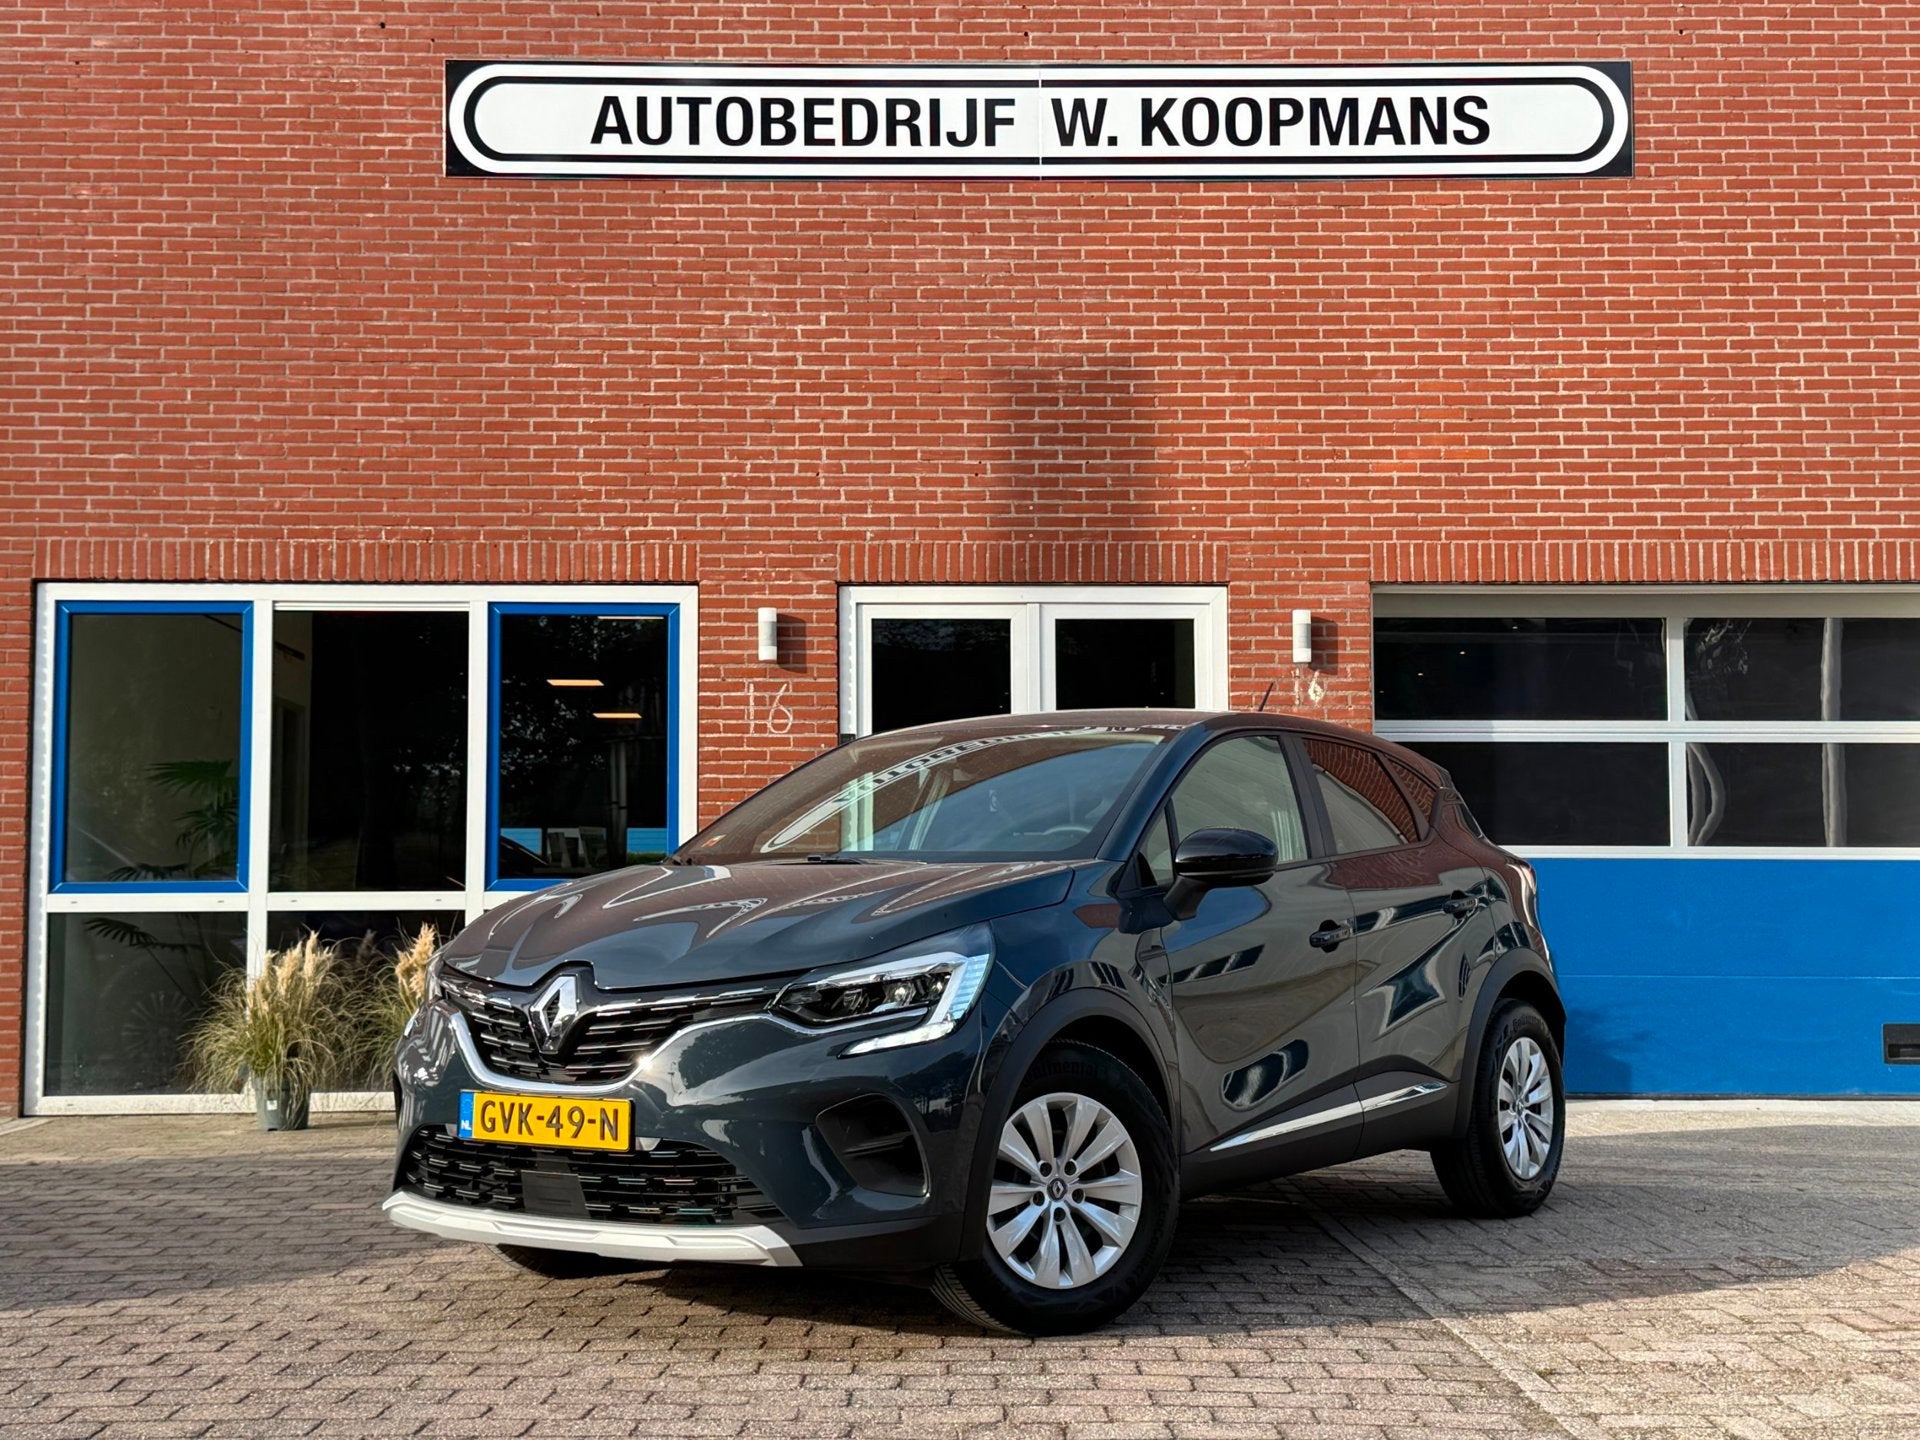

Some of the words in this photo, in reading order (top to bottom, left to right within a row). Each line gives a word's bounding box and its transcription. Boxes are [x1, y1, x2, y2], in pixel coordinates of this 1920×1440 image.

[590, 95, 1016, 147] AUTOBEDRIJF
[1052, 97, 1118, 147] W.
[1141, 95, 1491, 147] KOOPMANS
[1291, 667, 1326, 708] 16
[749, 683, 793, 735] 16
[460, 1119, 472, 1131] NL
[480, 1100, 619, 1142] GVK-49-N
